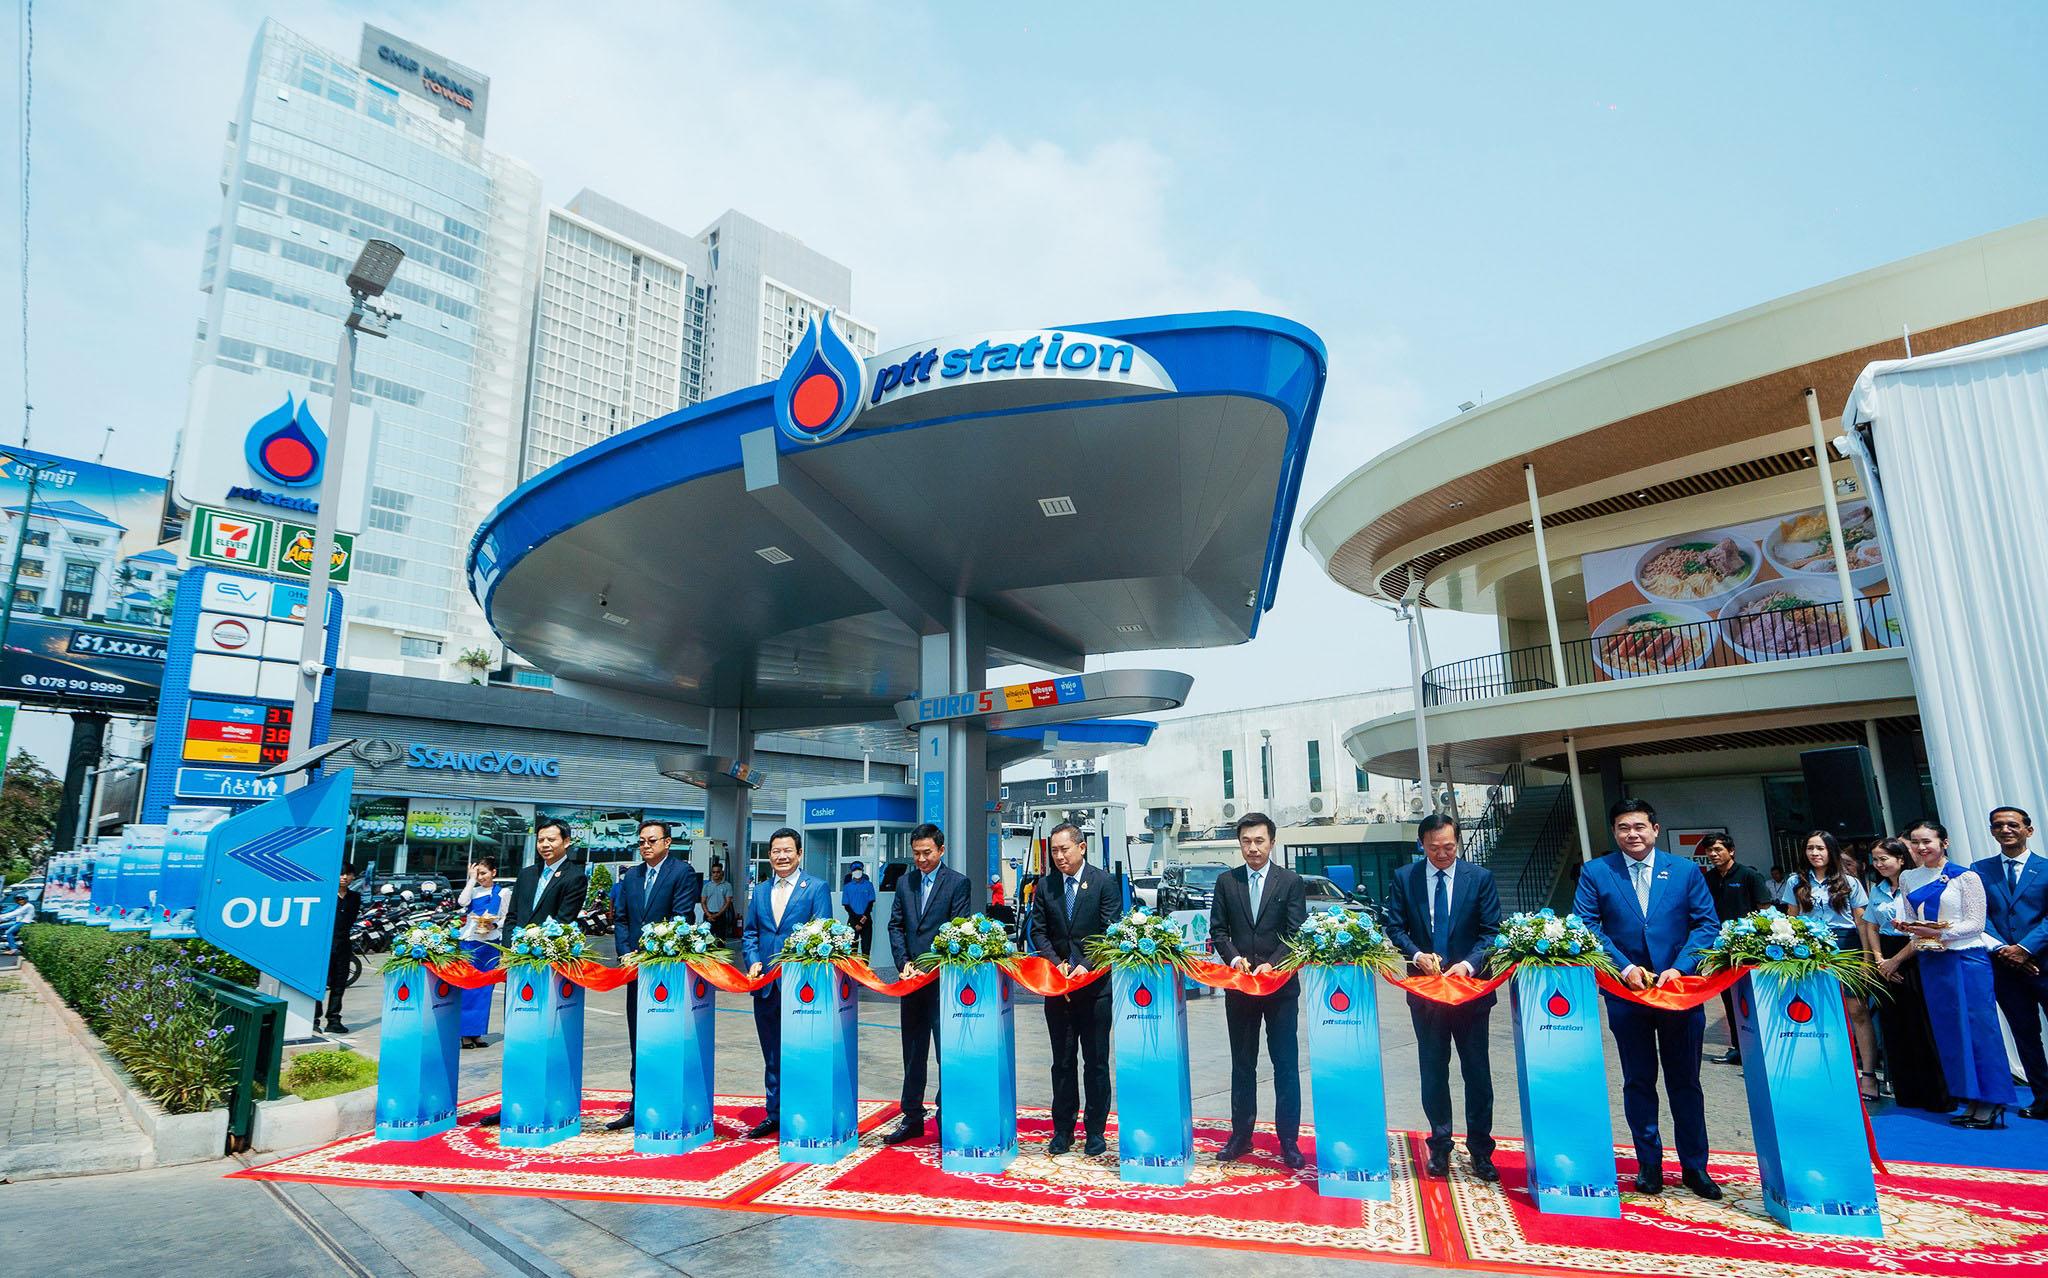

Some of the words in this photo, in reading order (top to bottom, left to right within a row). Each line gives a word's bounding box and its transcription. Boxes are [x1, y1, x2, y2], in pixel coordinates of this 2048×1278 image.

[422, 78, 474, 111] TOWER
[871, 347, 939, 404] ptt
[940, 332, 1135, 379] station
[40, 675, 67, 689] 078
[69, 679, 88, 690] 90
[90, 681, 125, 694] 9999
[919, 694, 975, 721] EURO
[978, 691, 994, 713] 5
[811, 808, 835, 817] Cashier
[411, 825, 470, 839] $59,999
[221, 896, 321, 929] OUT
